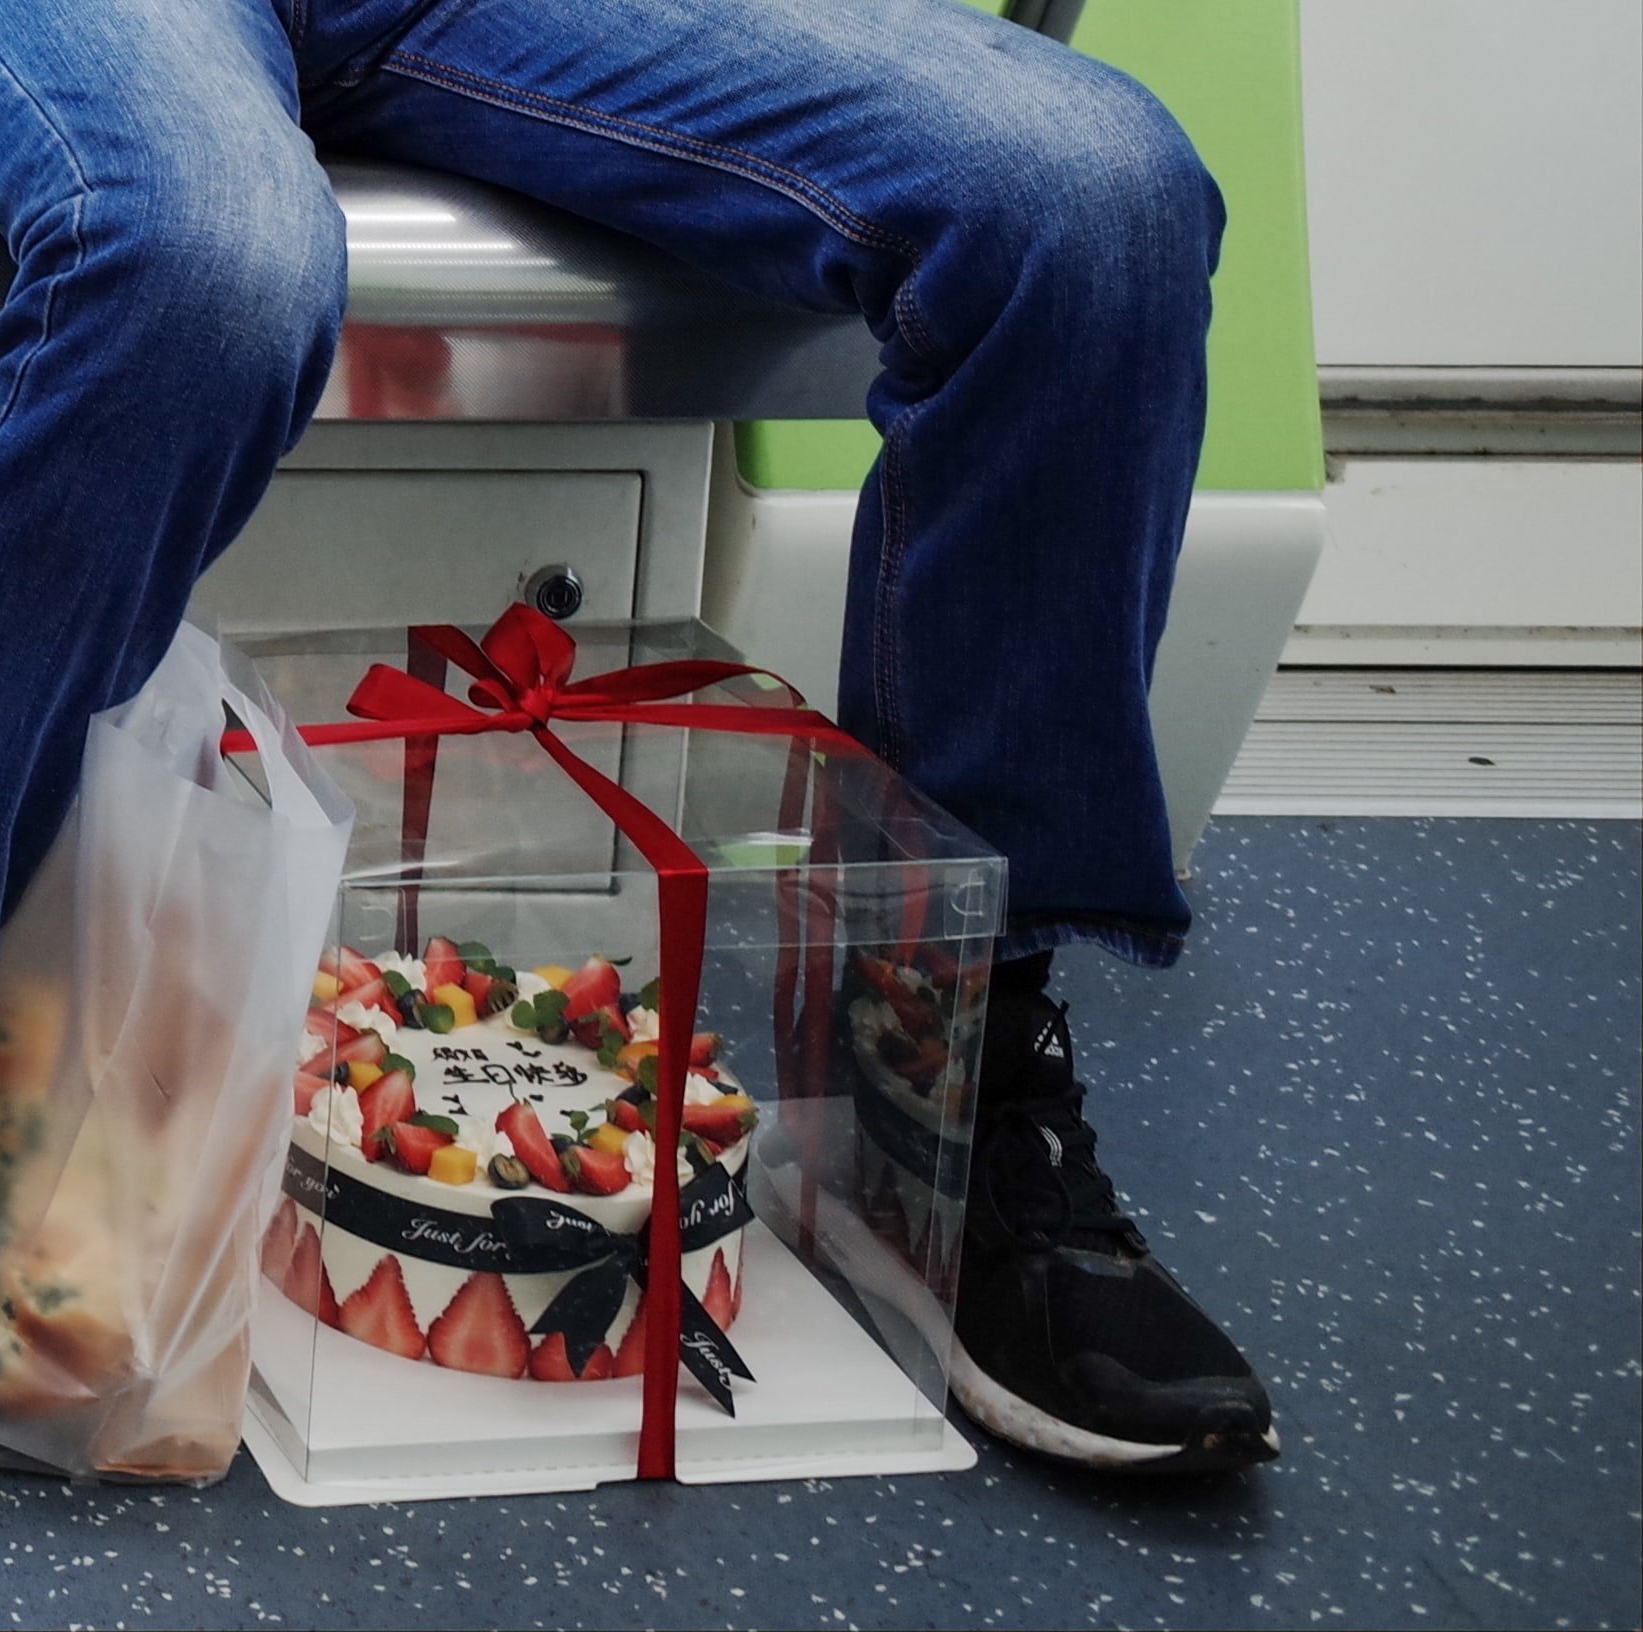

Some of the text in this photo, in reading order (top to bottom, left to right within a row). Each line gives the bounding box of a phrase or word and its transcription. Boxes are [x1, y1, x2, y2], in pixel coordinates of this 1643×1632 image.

[679, 1198, 706, 1230] yo
[402, 1218, 505, 1254] Just for
[680, 1330, 732, 1391] Just
